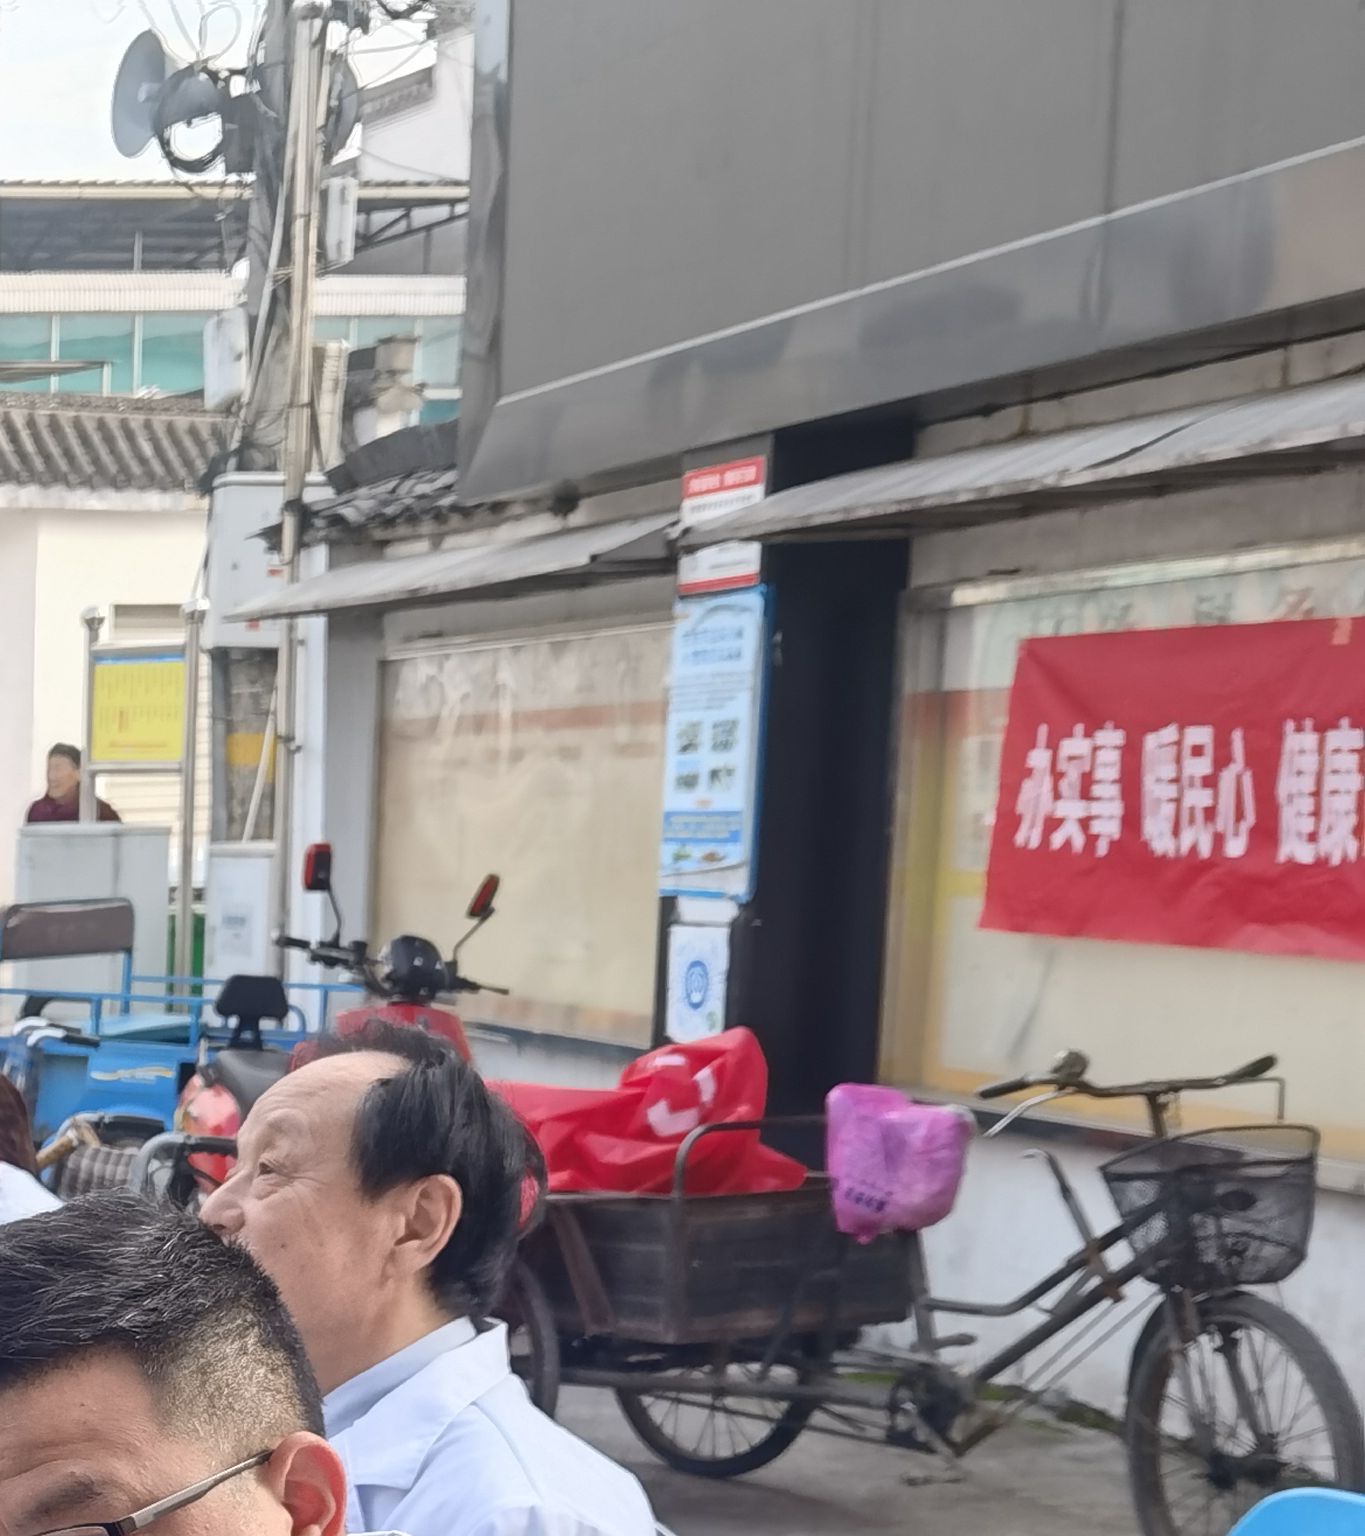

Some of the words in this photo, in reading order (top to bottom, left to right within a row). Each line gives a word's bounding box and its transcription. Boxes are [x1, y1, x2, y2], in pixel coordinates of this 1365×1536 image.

[1013, 720, 1127, 858] 办实事
[1140, 721, 1257, 860] 暖民心
